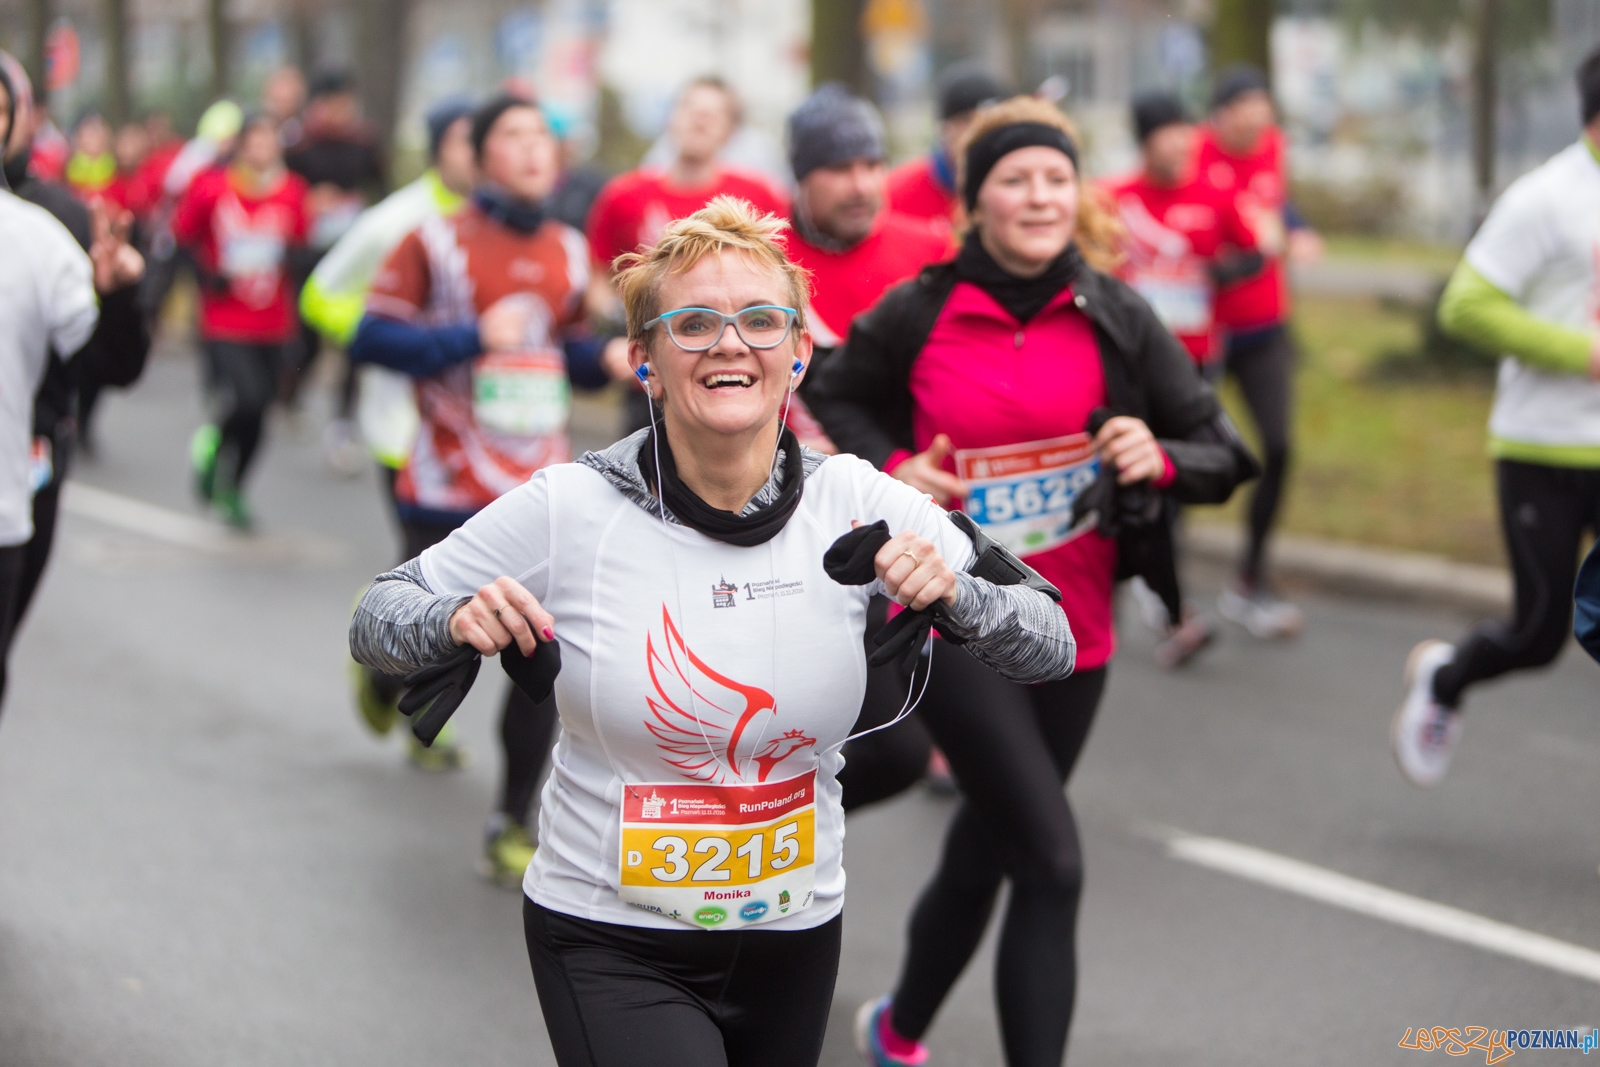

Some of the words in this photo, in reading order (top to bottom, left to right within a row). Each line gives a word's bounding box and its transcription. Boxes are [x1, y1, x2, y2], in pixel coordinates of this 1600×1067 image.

[743, 582, 755, 600] 1
[670, 798, 679, 815] 1
[739, 788, 806, 813] RunPoland.org
[627, 850, 643, 867] D
[650, 821, 800, 882] 3215
[703, 889, 751, 901] Monika
